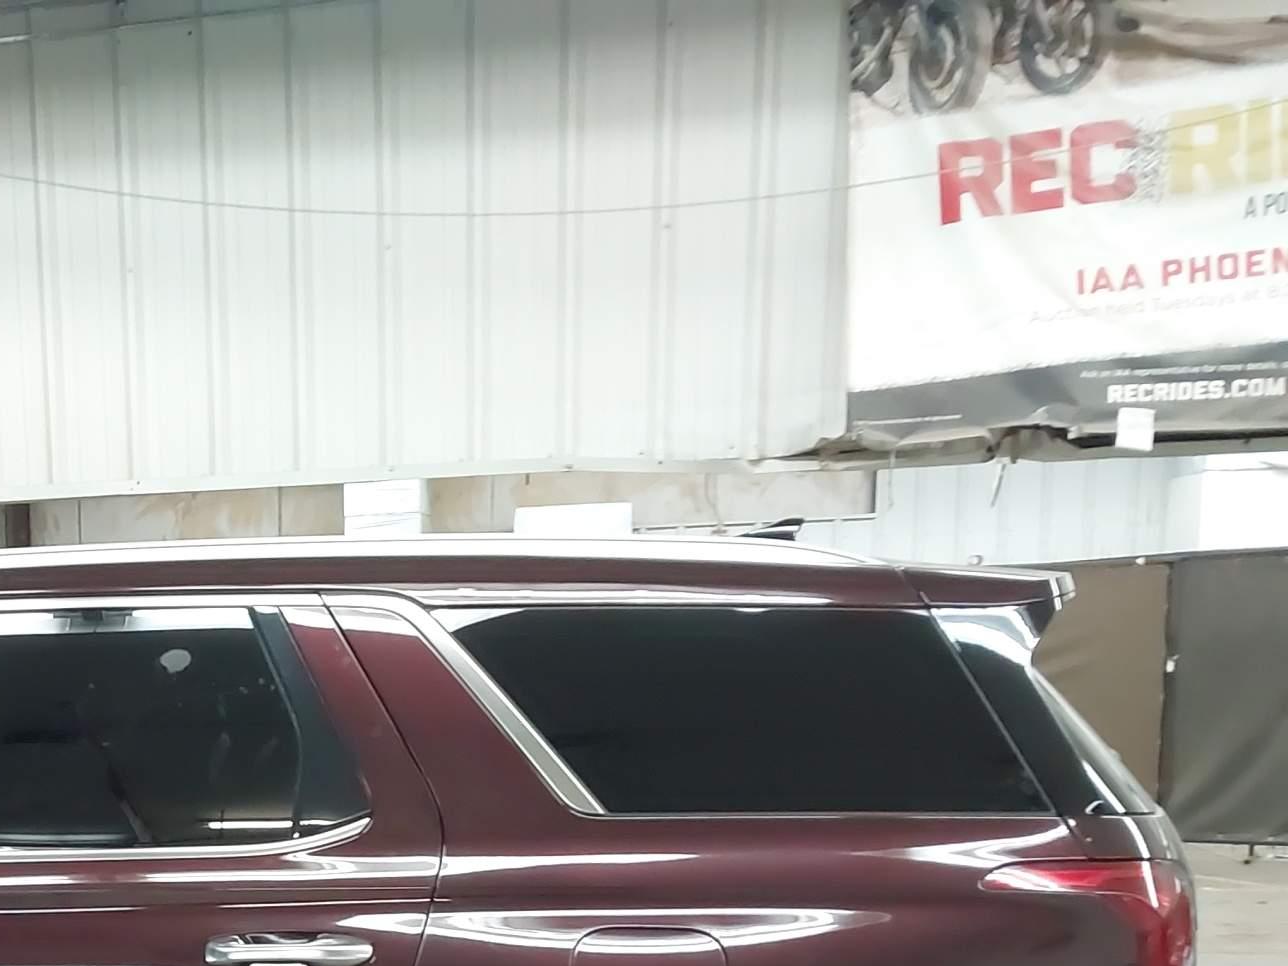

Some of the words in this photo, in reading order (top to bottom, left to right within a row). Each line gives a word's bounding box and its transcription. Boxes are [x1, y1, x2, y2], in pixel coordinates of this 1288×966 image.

[938, 119, 1138, 226] REC
[1171, 97, 1288, 194] RI
[1077, 263, 1145, 296] IAA
[1106, 376, 1287, 404] RECRIDES.COM
